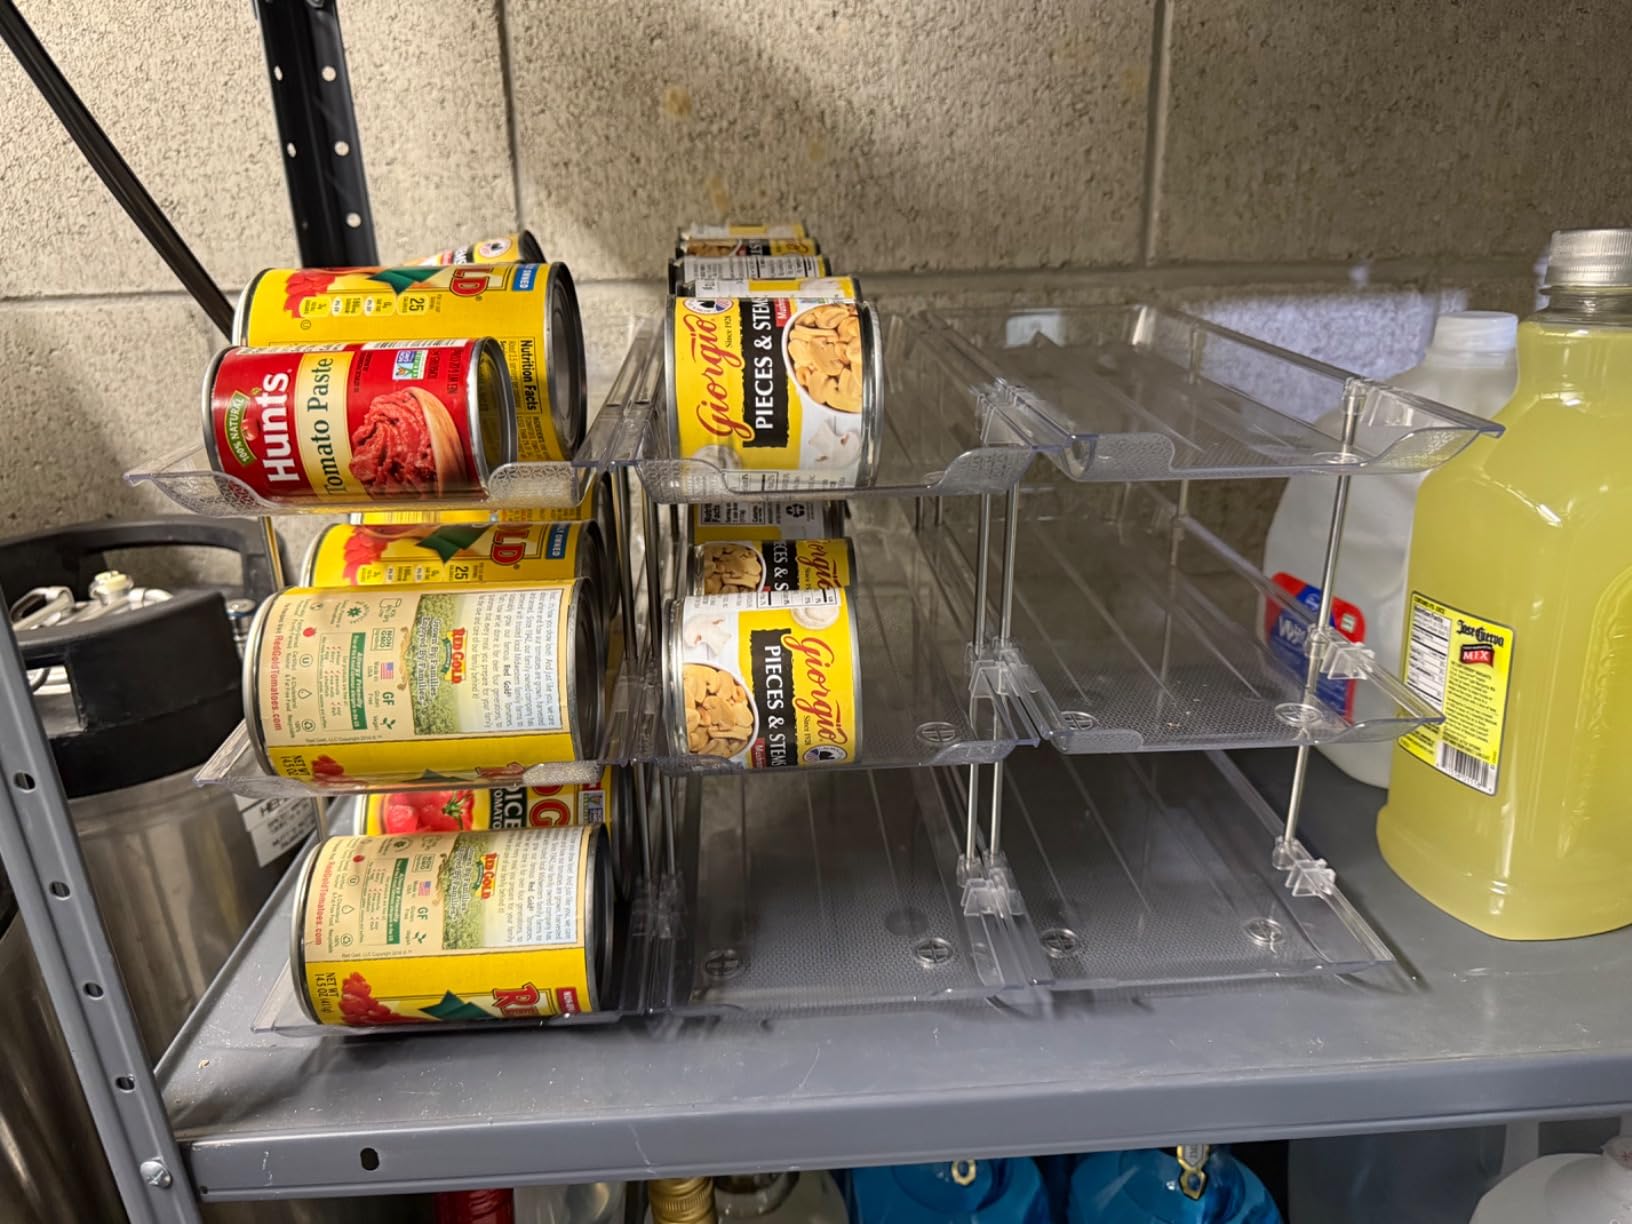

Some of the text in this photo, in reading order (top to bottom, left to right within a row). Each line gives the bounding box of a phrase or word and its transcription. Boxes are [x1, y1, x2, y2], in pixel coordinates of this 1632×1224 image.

[520, 270, 532, 288] OWNED
[409, 298, 425, 311] 25
[754, 335, 773, 350] &
[521, 340, 538, 410] Nutrition Facts
[683, 313, 754, 440] Giorgio
[755, 357, 773, 429] PIECES
[229, 397, 249, 462] 100% NATURAL
[307, 359, 346, 495] Tomato Paste
[455, 566, 469, 580] 25
[774, 567, 788, 578] &
[431, 619, 441, 645] Grown
[1457, 619, 1504, 647] Jose Cuervo
[355, 652, 363, 676] Allergy
[418, 650, 429, 661] By
[429, 646, 440, 658] By
[451, 628, 466, 684] RED GOLD
[523, 655, 532, 673] family
[1463, 651, 1489, 661] MIX
[270, 635, 284, 731] RedGoldTomatoes.com
[765, 645, 784, 710] PIECES
[356, 678, 364, 708] Friendly
[383, 692, 394, 706] GF
[782, 635, 848, 746] Giorgio
[524, 693, 532, 716] company
[768, 715, 785, 729] &
[481, 853, 497, 900] RED GOLD
[315, 861, 335, 945] RedGoldTomatoes.com
[418, 907, 428, 921] GF
[318, 988, 328, 996] OZ
[327, 972, 339, 997] NET WT
